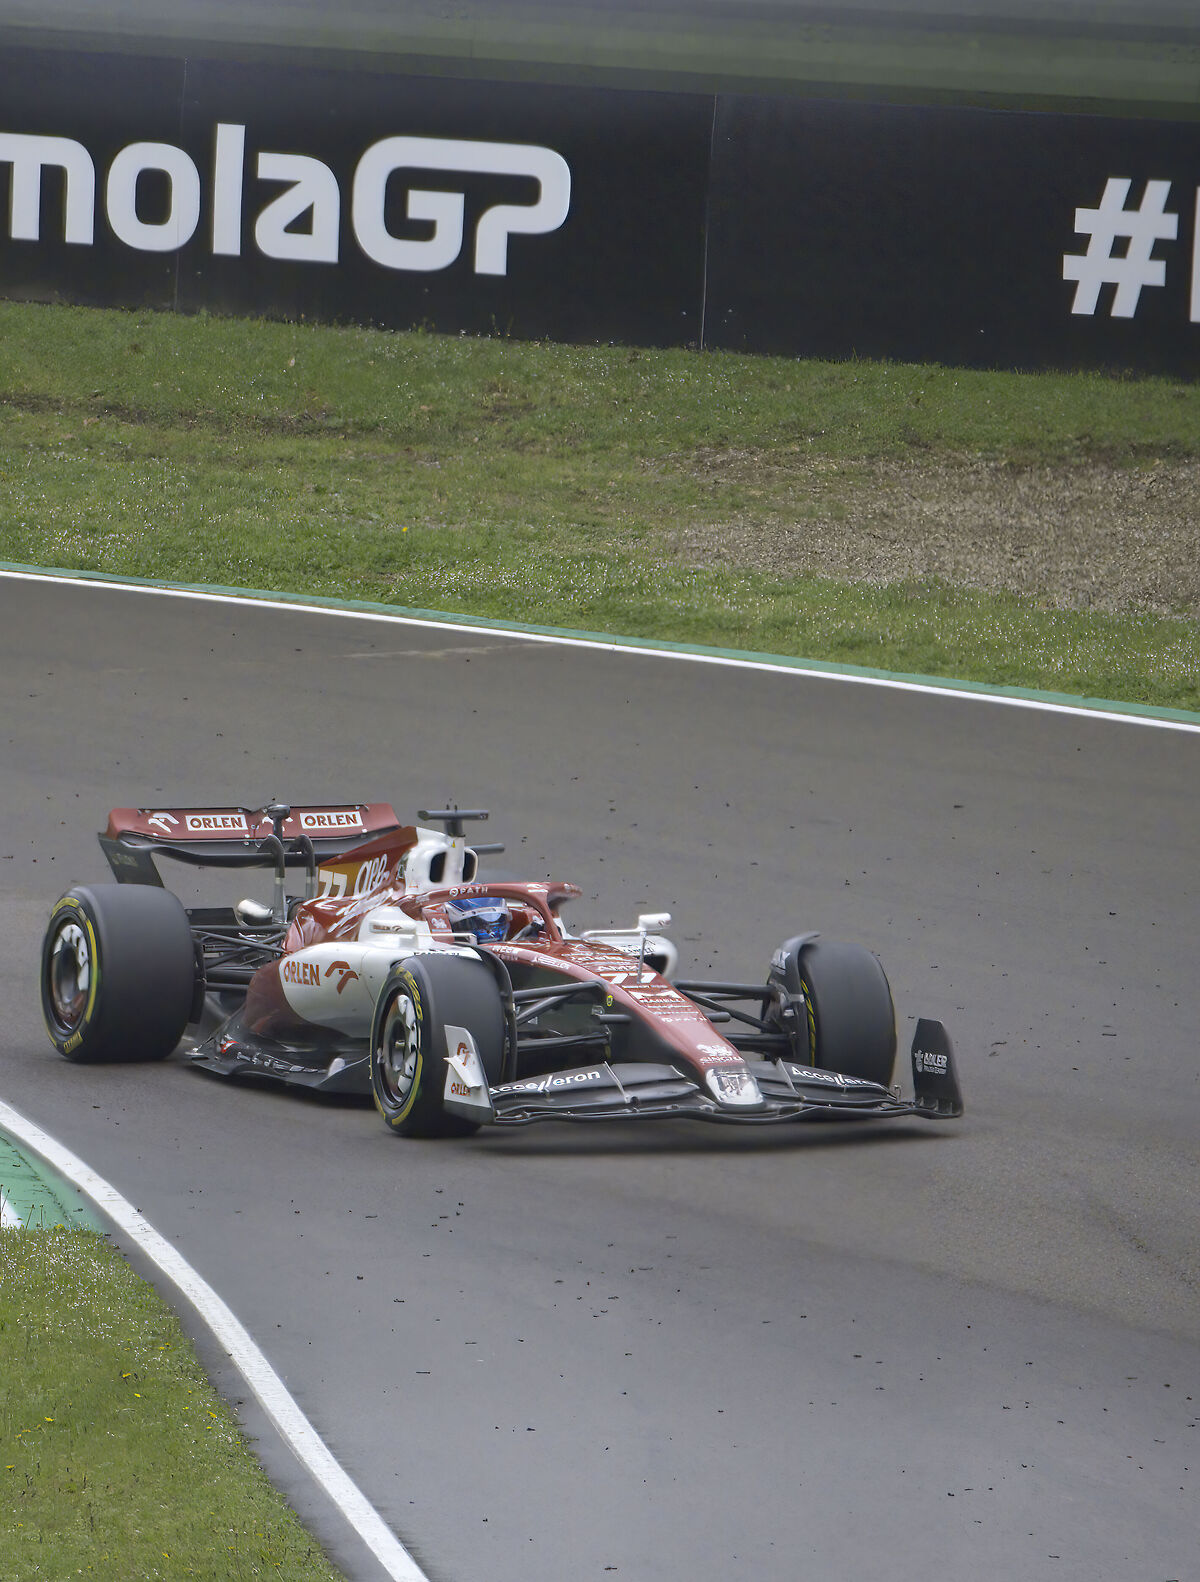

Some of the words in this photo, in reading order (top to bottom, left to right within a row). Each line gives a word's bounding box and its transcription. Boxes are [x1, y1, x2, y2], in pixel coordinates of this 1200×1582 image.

[189, 816, 243, 830] ORLEN
[304, 813, 358, 827] ORLEN
[283, 961, 321, 986] ORLEN
[488, 1071, 601, 1095] Accelleron
